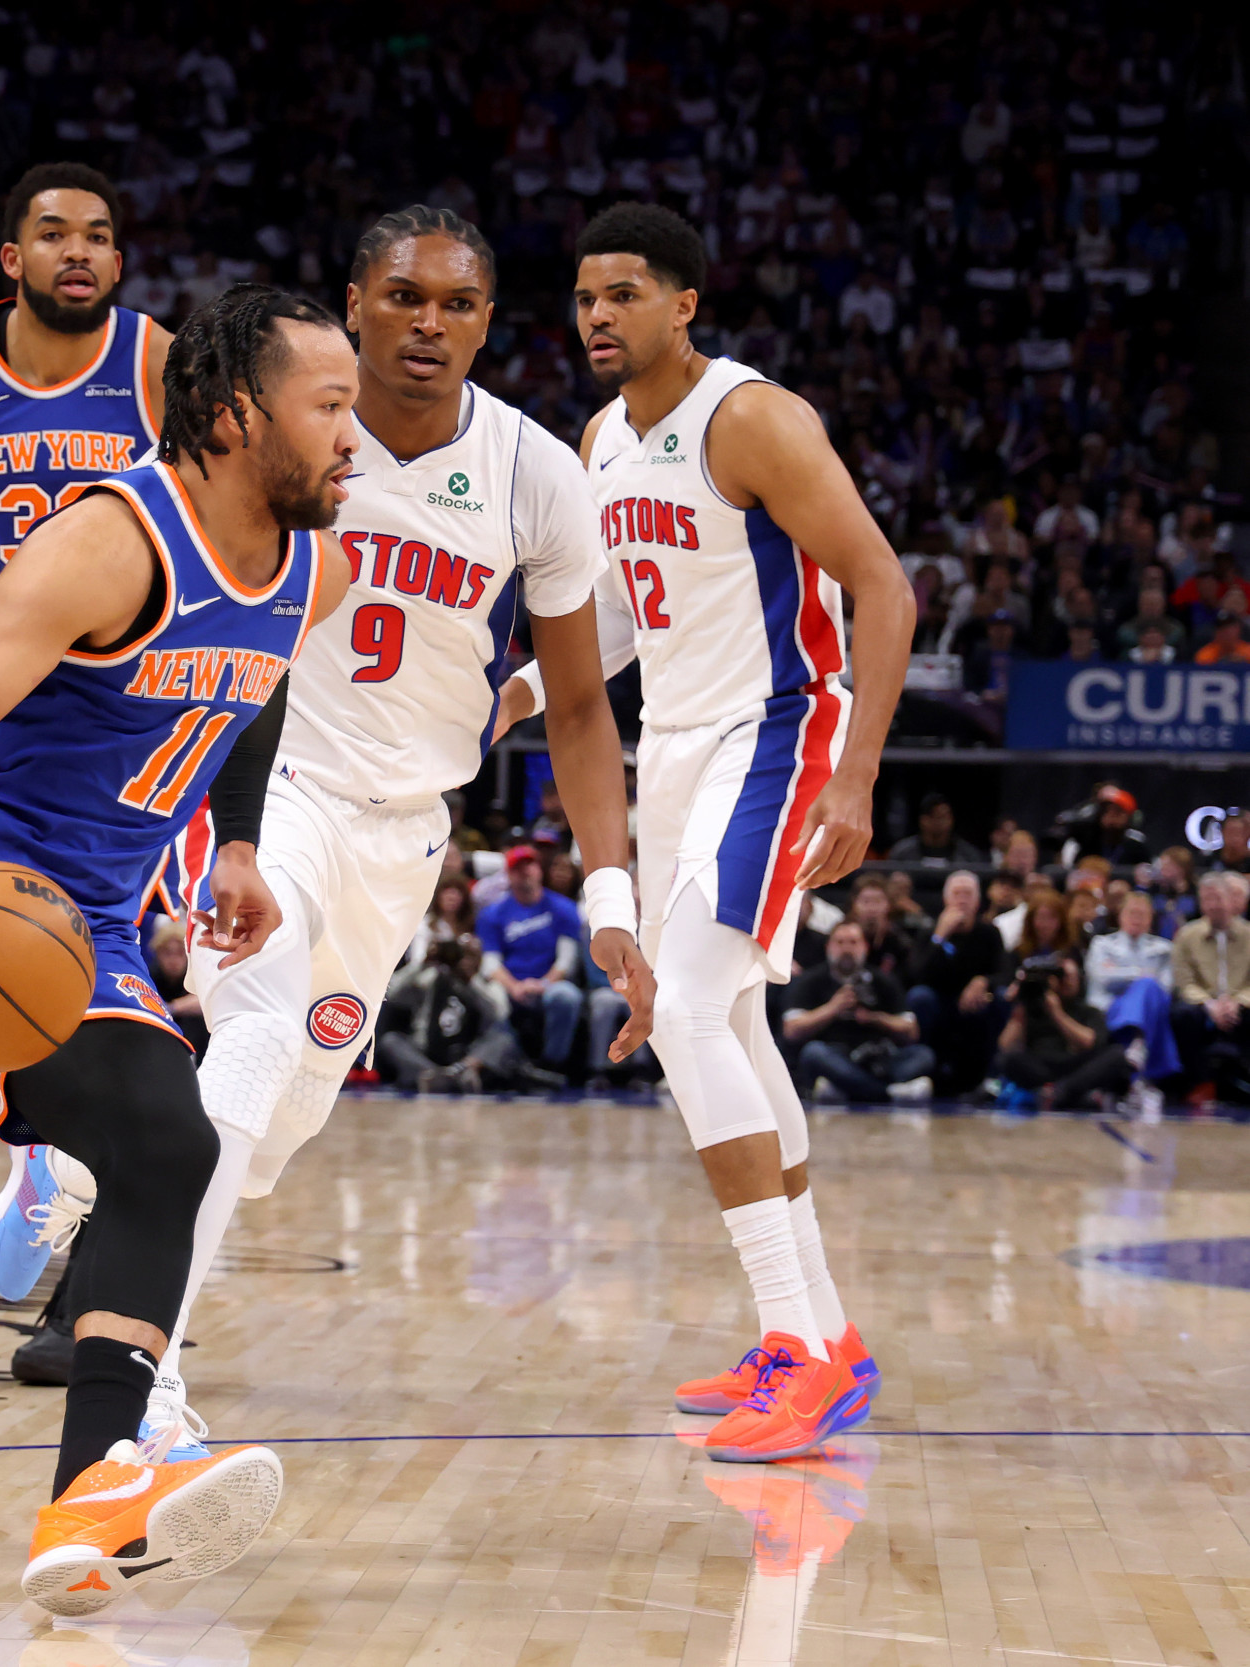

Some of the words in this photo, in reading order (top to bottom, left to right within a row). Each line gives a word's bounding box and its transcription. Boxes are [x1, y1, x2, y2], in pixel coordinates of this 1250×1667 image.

[42, 430, 136, 474] YORK
[650, 453, 687, 465] StockX
[426, 491, 485, 513] StockX
[600, 497, 699, 551] ISTONS
[334, 530, 495, 609] STONS
[620, 559, 671, 630] 12
[351, 603, 406, 683] 9
[123, 647, 231, 701] NEW
[1066, 667, 1250, 725] CUR
[117, 706, 237, 818] 11
[1067, 725, 1234, 747] INSURANCE
[317, 1013, 352, 1036] PISTONS
[323, 1005, 358, 1027] DETROIT
